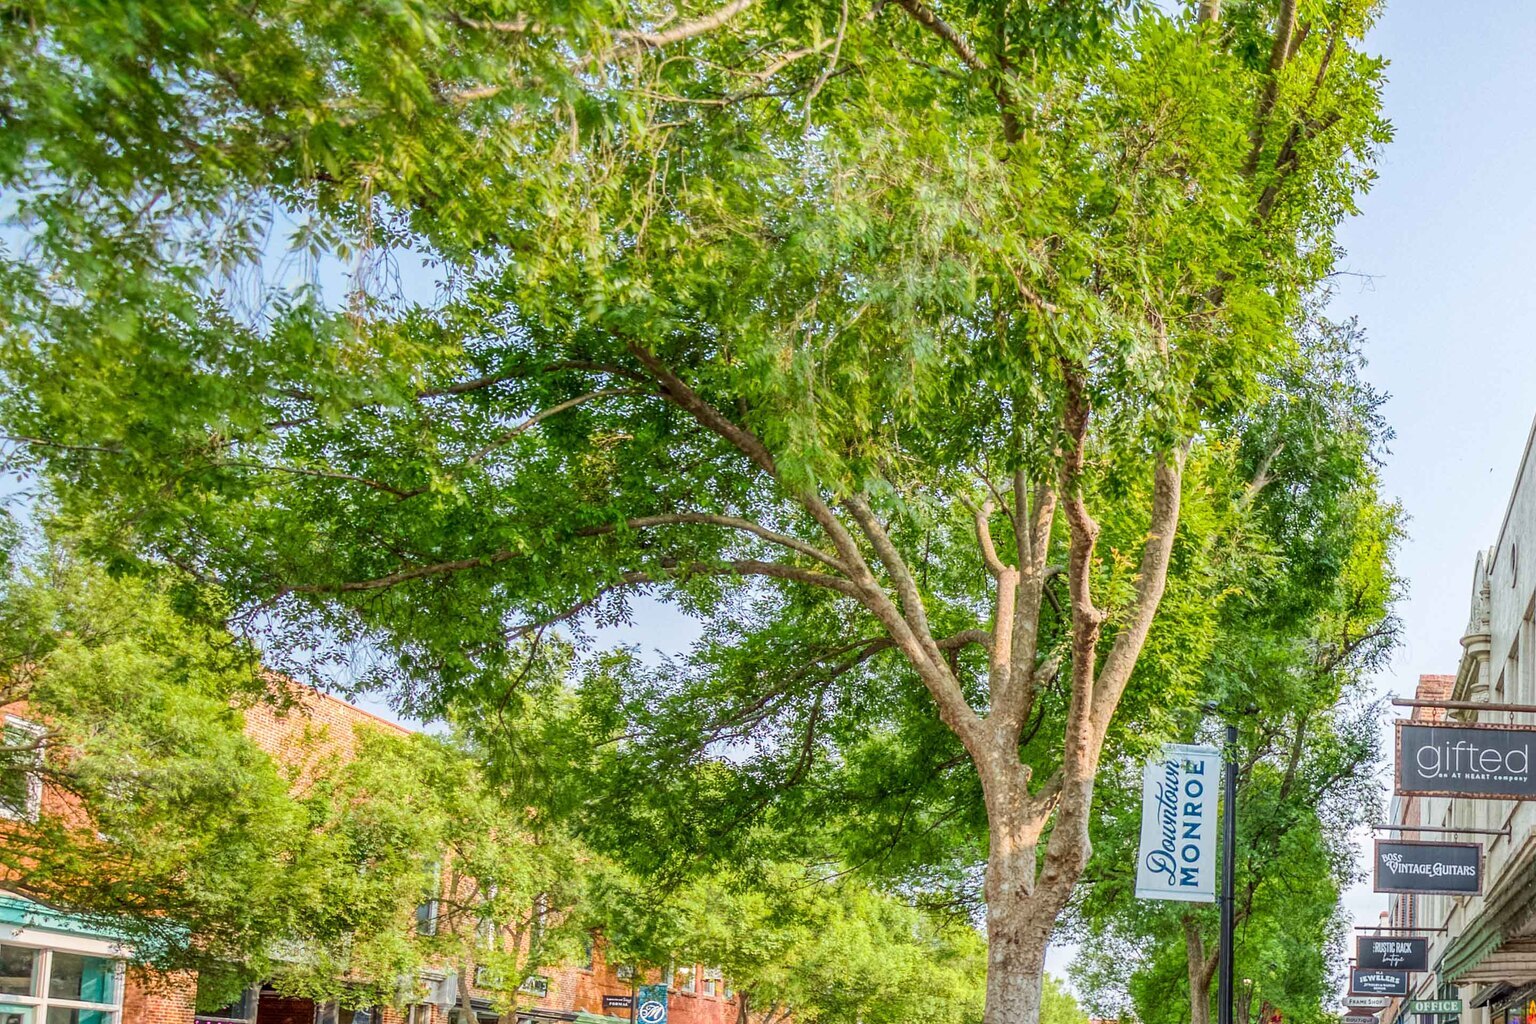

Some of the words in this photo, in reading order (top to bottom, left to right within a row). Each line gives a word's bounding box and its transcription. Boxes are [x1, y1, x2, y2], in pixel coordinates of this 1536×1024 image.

[1416, 741, 1529, 778] gifted
[1146, 758, 1180, 887] Downtown
[1180, 760, 1205, 887] MONROE
[1381, 853, 1403, 863] BOSS
[1385, 861, 1432, 874] VINTAGE
[1430, 862, 1476, 877] GUITARS
[1374, 942, 1395, 953] RUSTIC
[1396, 942, 1412, 953] RACK
[1415, 1001, 1459, 1011] OFFICE
